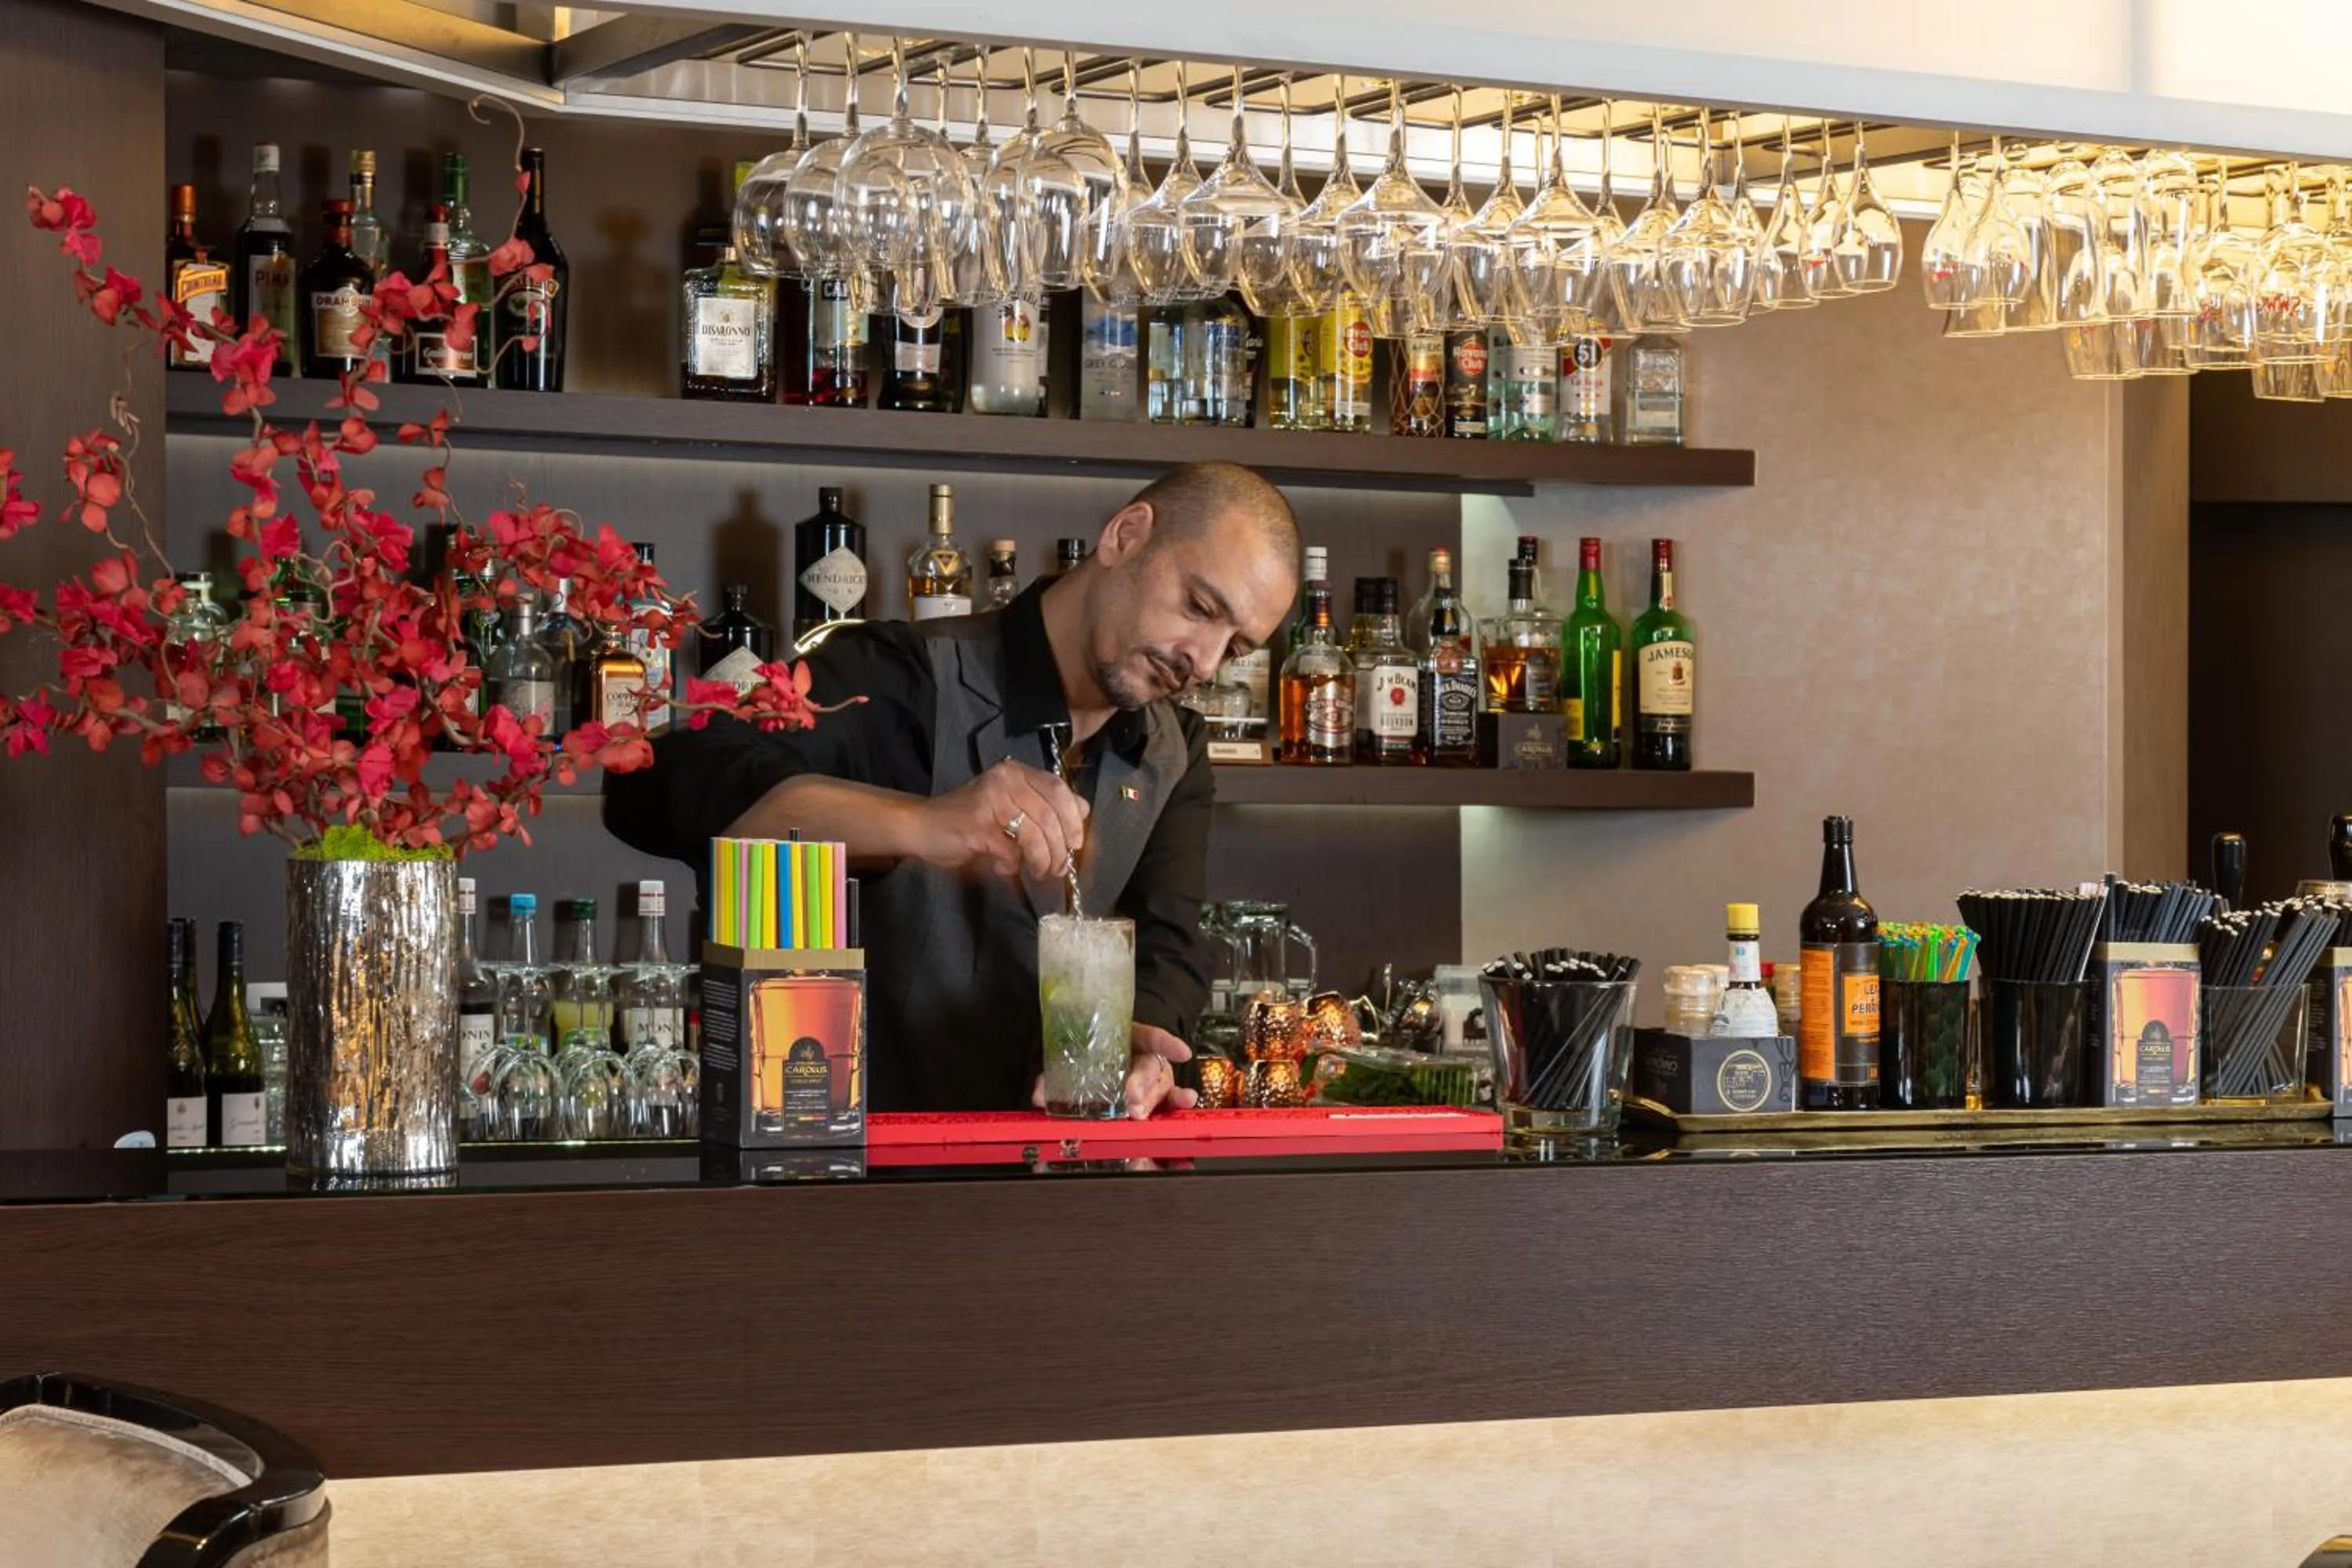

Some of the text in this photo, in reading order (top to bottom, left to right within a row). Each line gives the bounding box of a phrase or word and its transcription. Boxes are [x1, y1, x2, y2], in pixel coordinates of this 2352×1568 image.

[702, 324, 750, 337] DISARONNO
[1577, 343, 1596, 364] 51
[1377, 676, 1393, 691] JM
[461, 1029, 492, 1040] ONIN
[786, 1065, 828, 1076] CAROLUS
